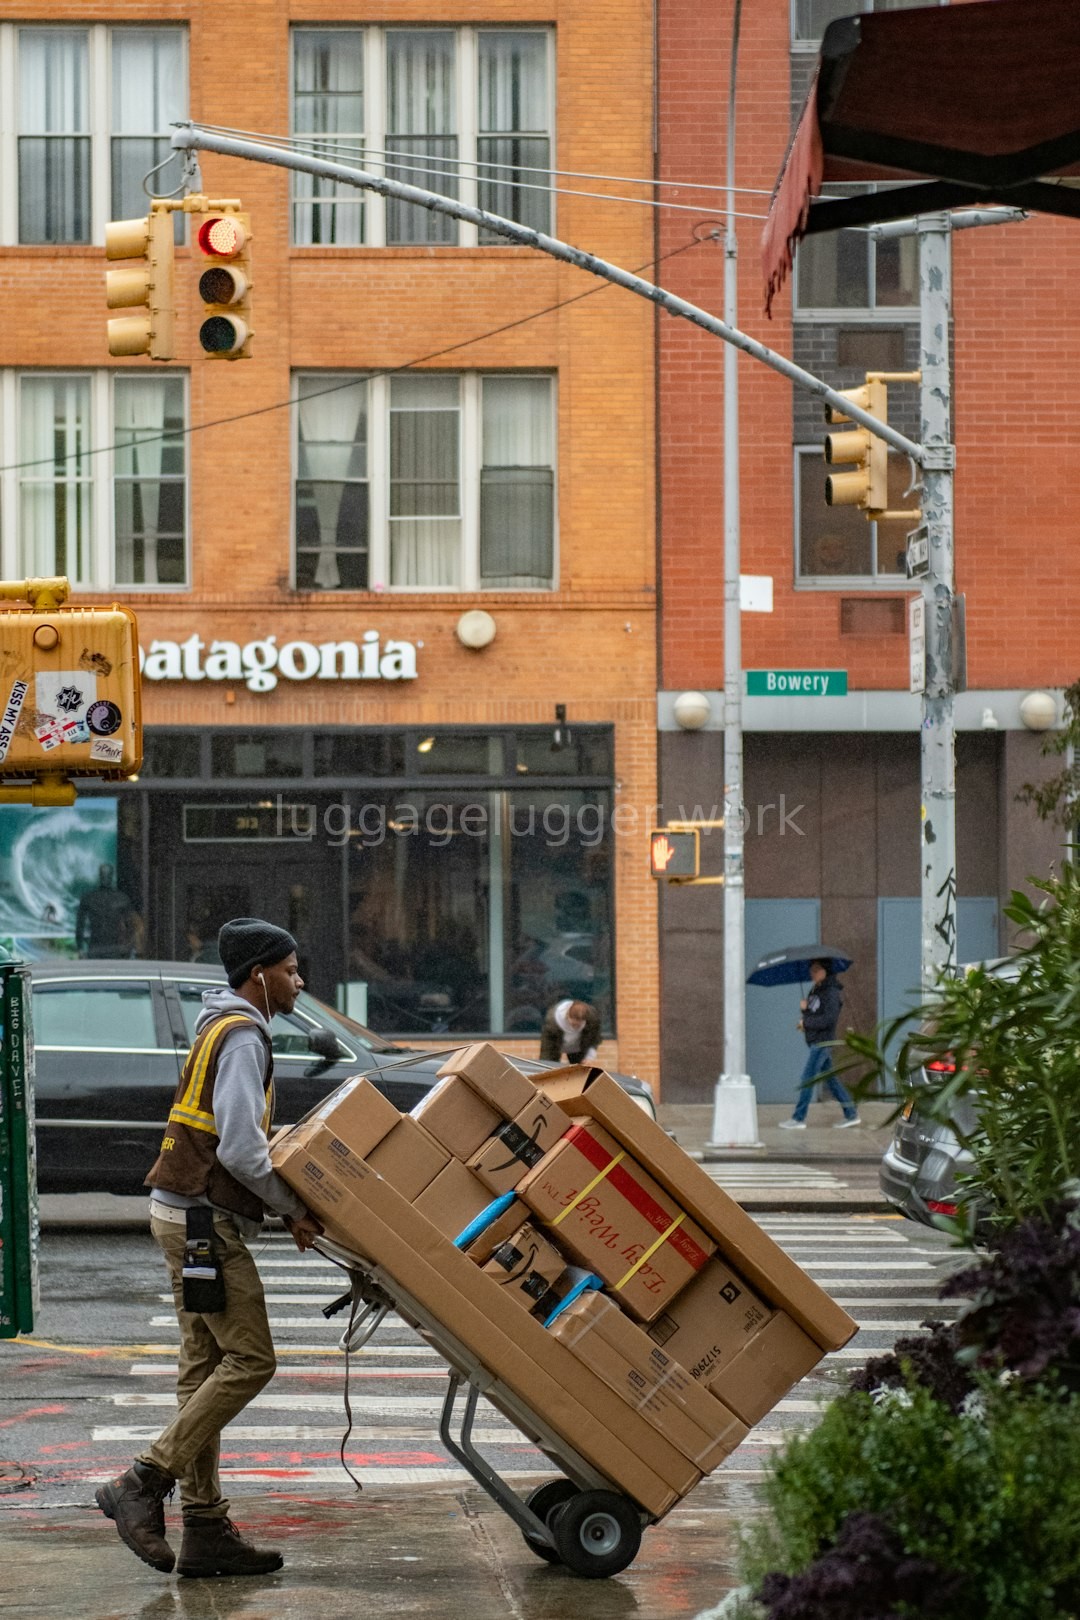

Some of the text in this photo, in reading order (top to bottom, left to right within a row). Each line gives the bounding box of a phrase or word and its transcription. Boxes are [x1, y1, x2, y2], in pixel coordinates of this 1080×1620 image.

[139, 630, 418, 692] atagonia
[766, 672, 829, 696] Bowery
[0, 681, 27, 748] KISS MY ASS
[559, 1188, 620, 1249] Weigh
[621, 1243, 666, 1294] Easy
[679, 1238, 700, 1261] Easy
